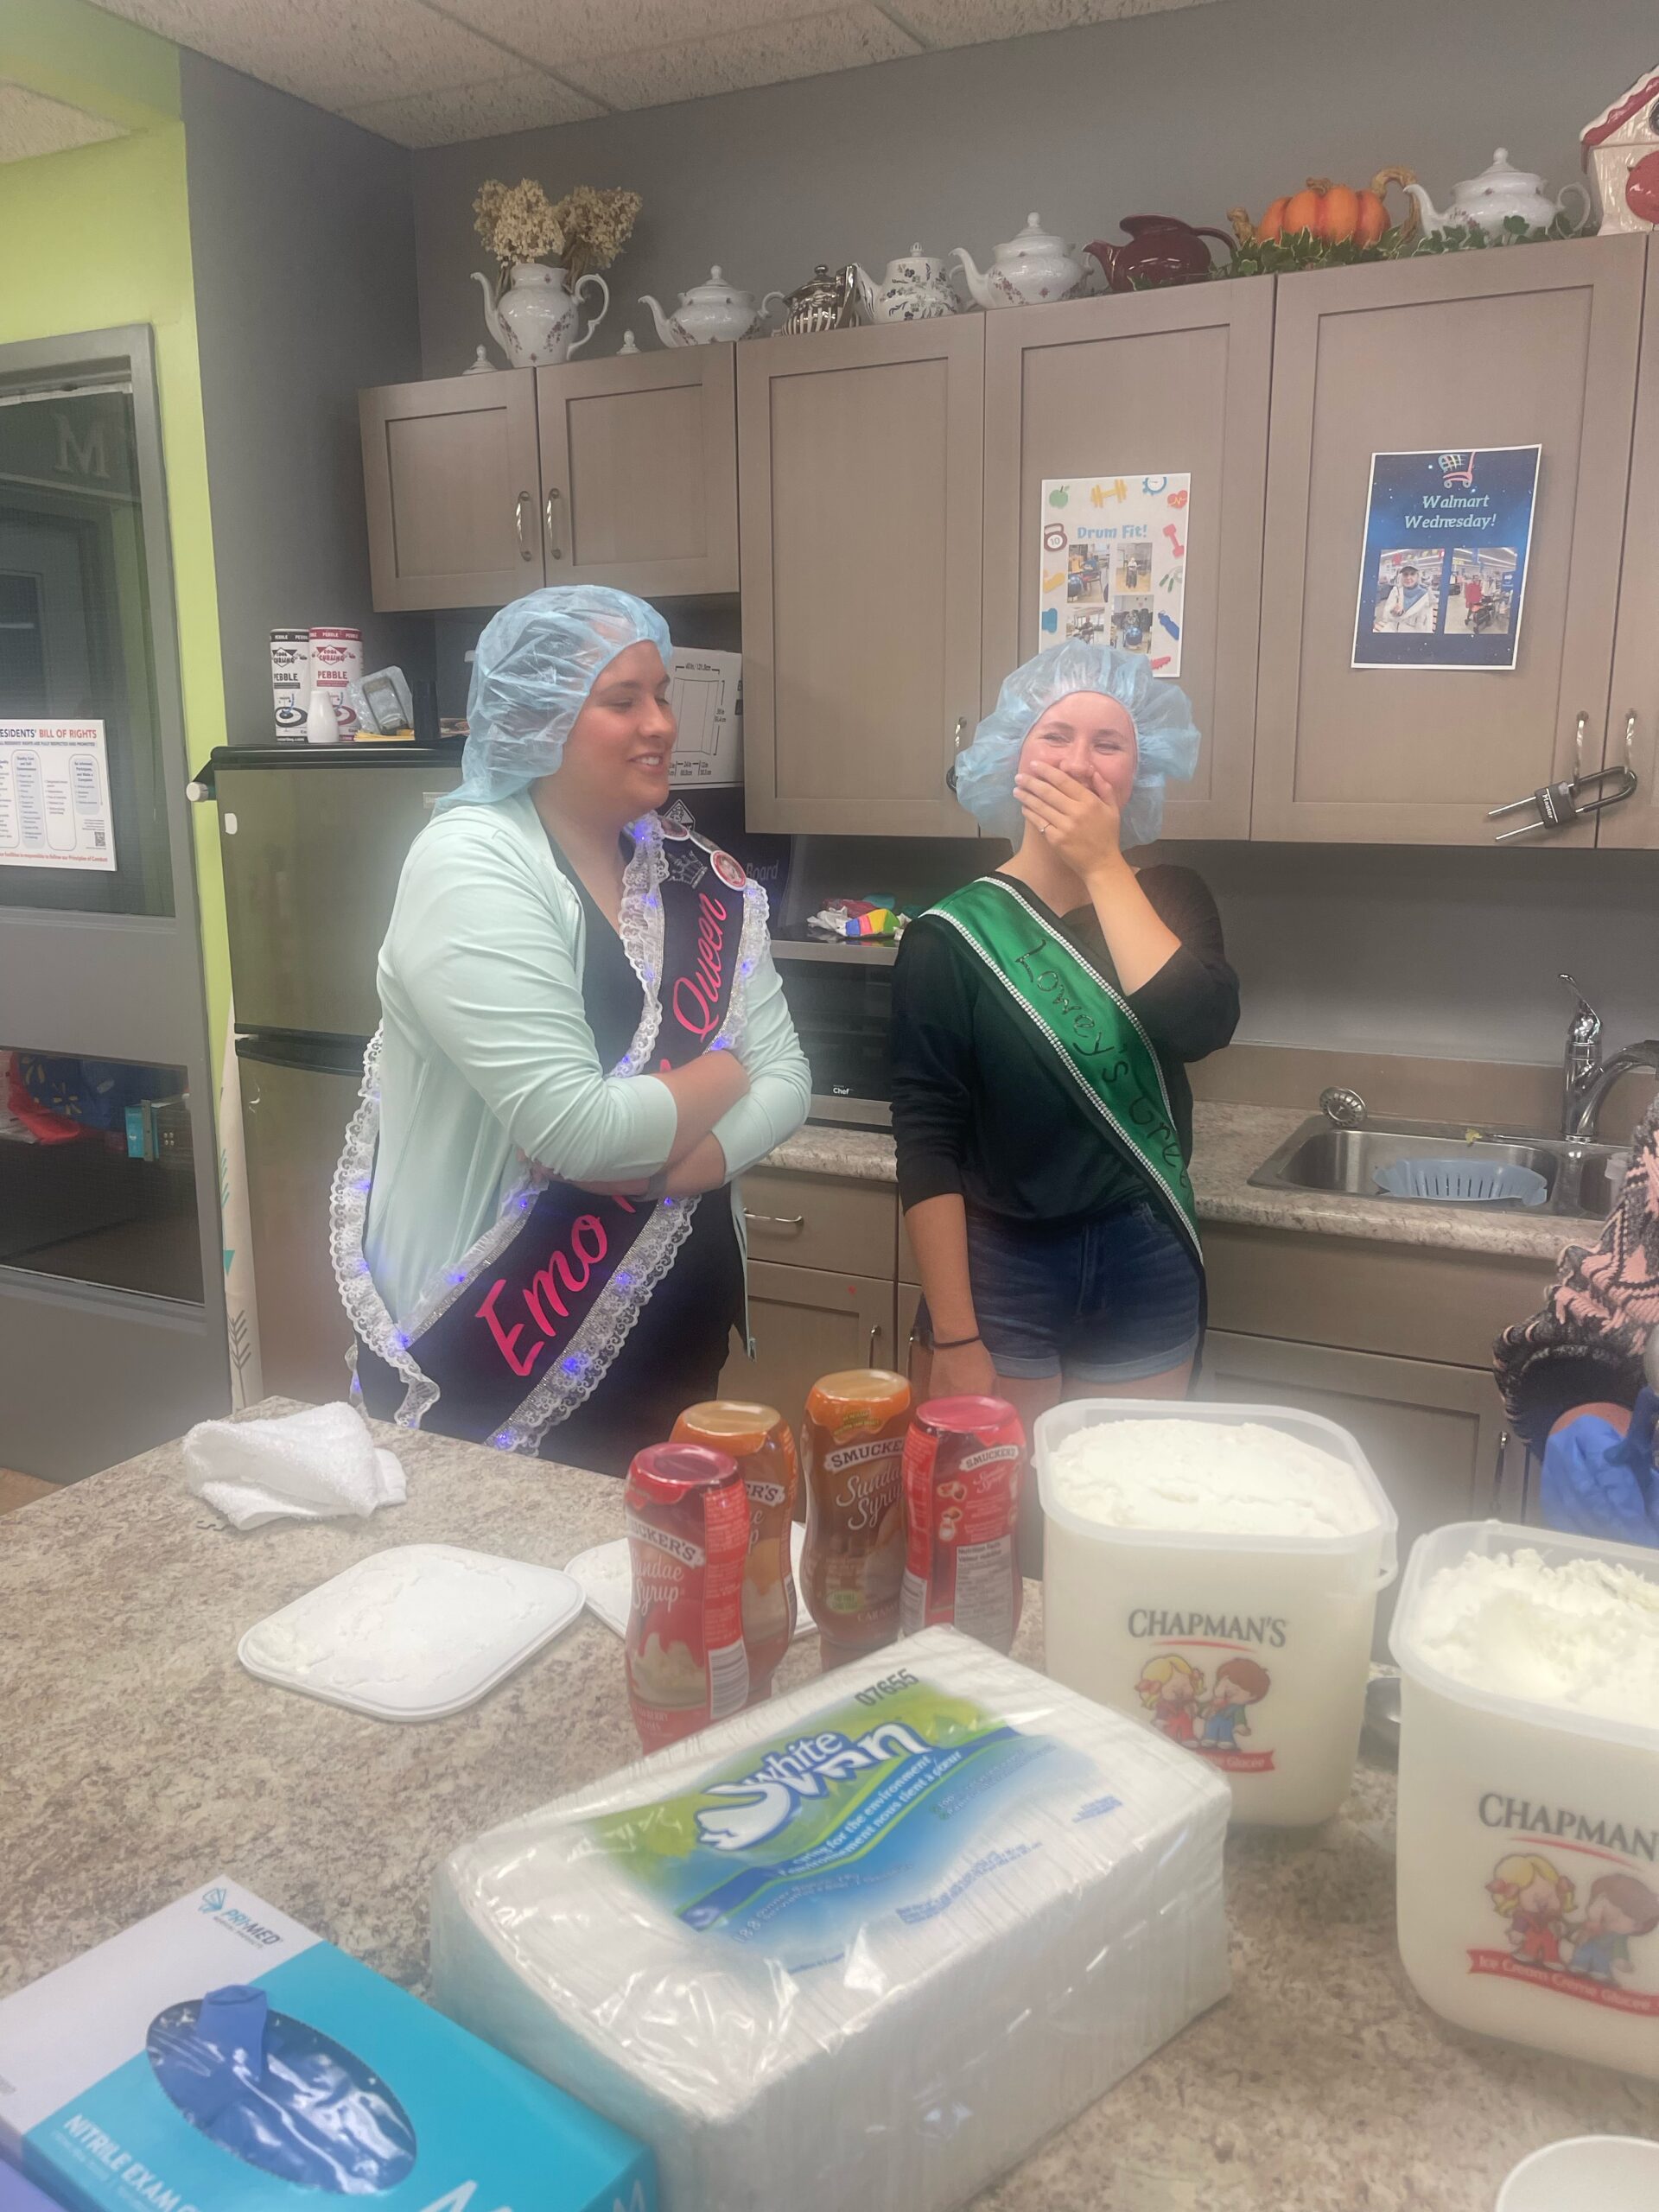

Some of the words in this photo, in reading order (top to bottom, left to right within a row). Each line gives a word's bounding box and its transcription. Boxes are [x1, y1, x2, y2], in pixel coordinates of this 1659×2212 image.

[1422, 494, 1491, 509] Walmart
[1077, 526, 1117, 539] Drum
[1122, 524, 1147, 538] Fit!
[1404, 514, 1497, 530] Wednesday!
[317, 671, 347, 679] PEBBLE
[0, 729, 37, 738] ESIDENTS'
[39, 729, 54, 738] BILL
[69, 730, 97, 739] RIGHTS
[1541, 793, 1554, 819] Master
[475, 1213, 608, 1376] Emo
[672, 892, 728, 1043] Queen
[830, 1438, 905, 1468] SMUCKE
[836, 1460, 900, 1507] Sunda
[632, 1576, 679, 1617] Syrup
[1127, 1608, 1287, 1649] CHAPMAN'S
[854, 1667, 918, 1707] 07655
[826, 1831, 848, 1849] for
[844, 1814, 867, 1834] the
[864, 1754, 931, 1816] environment
[874, 1801, 903, 1827] nous
[899, 1779, 929, 1803] tient
[1478, 1791, 1659, 1863] CHAPMAN
[1478, 1955, 1499, 1968] Ice
[63, 2113, 133, 2171] NITRILE
[120, 2163, 181, 2212] EXAM
